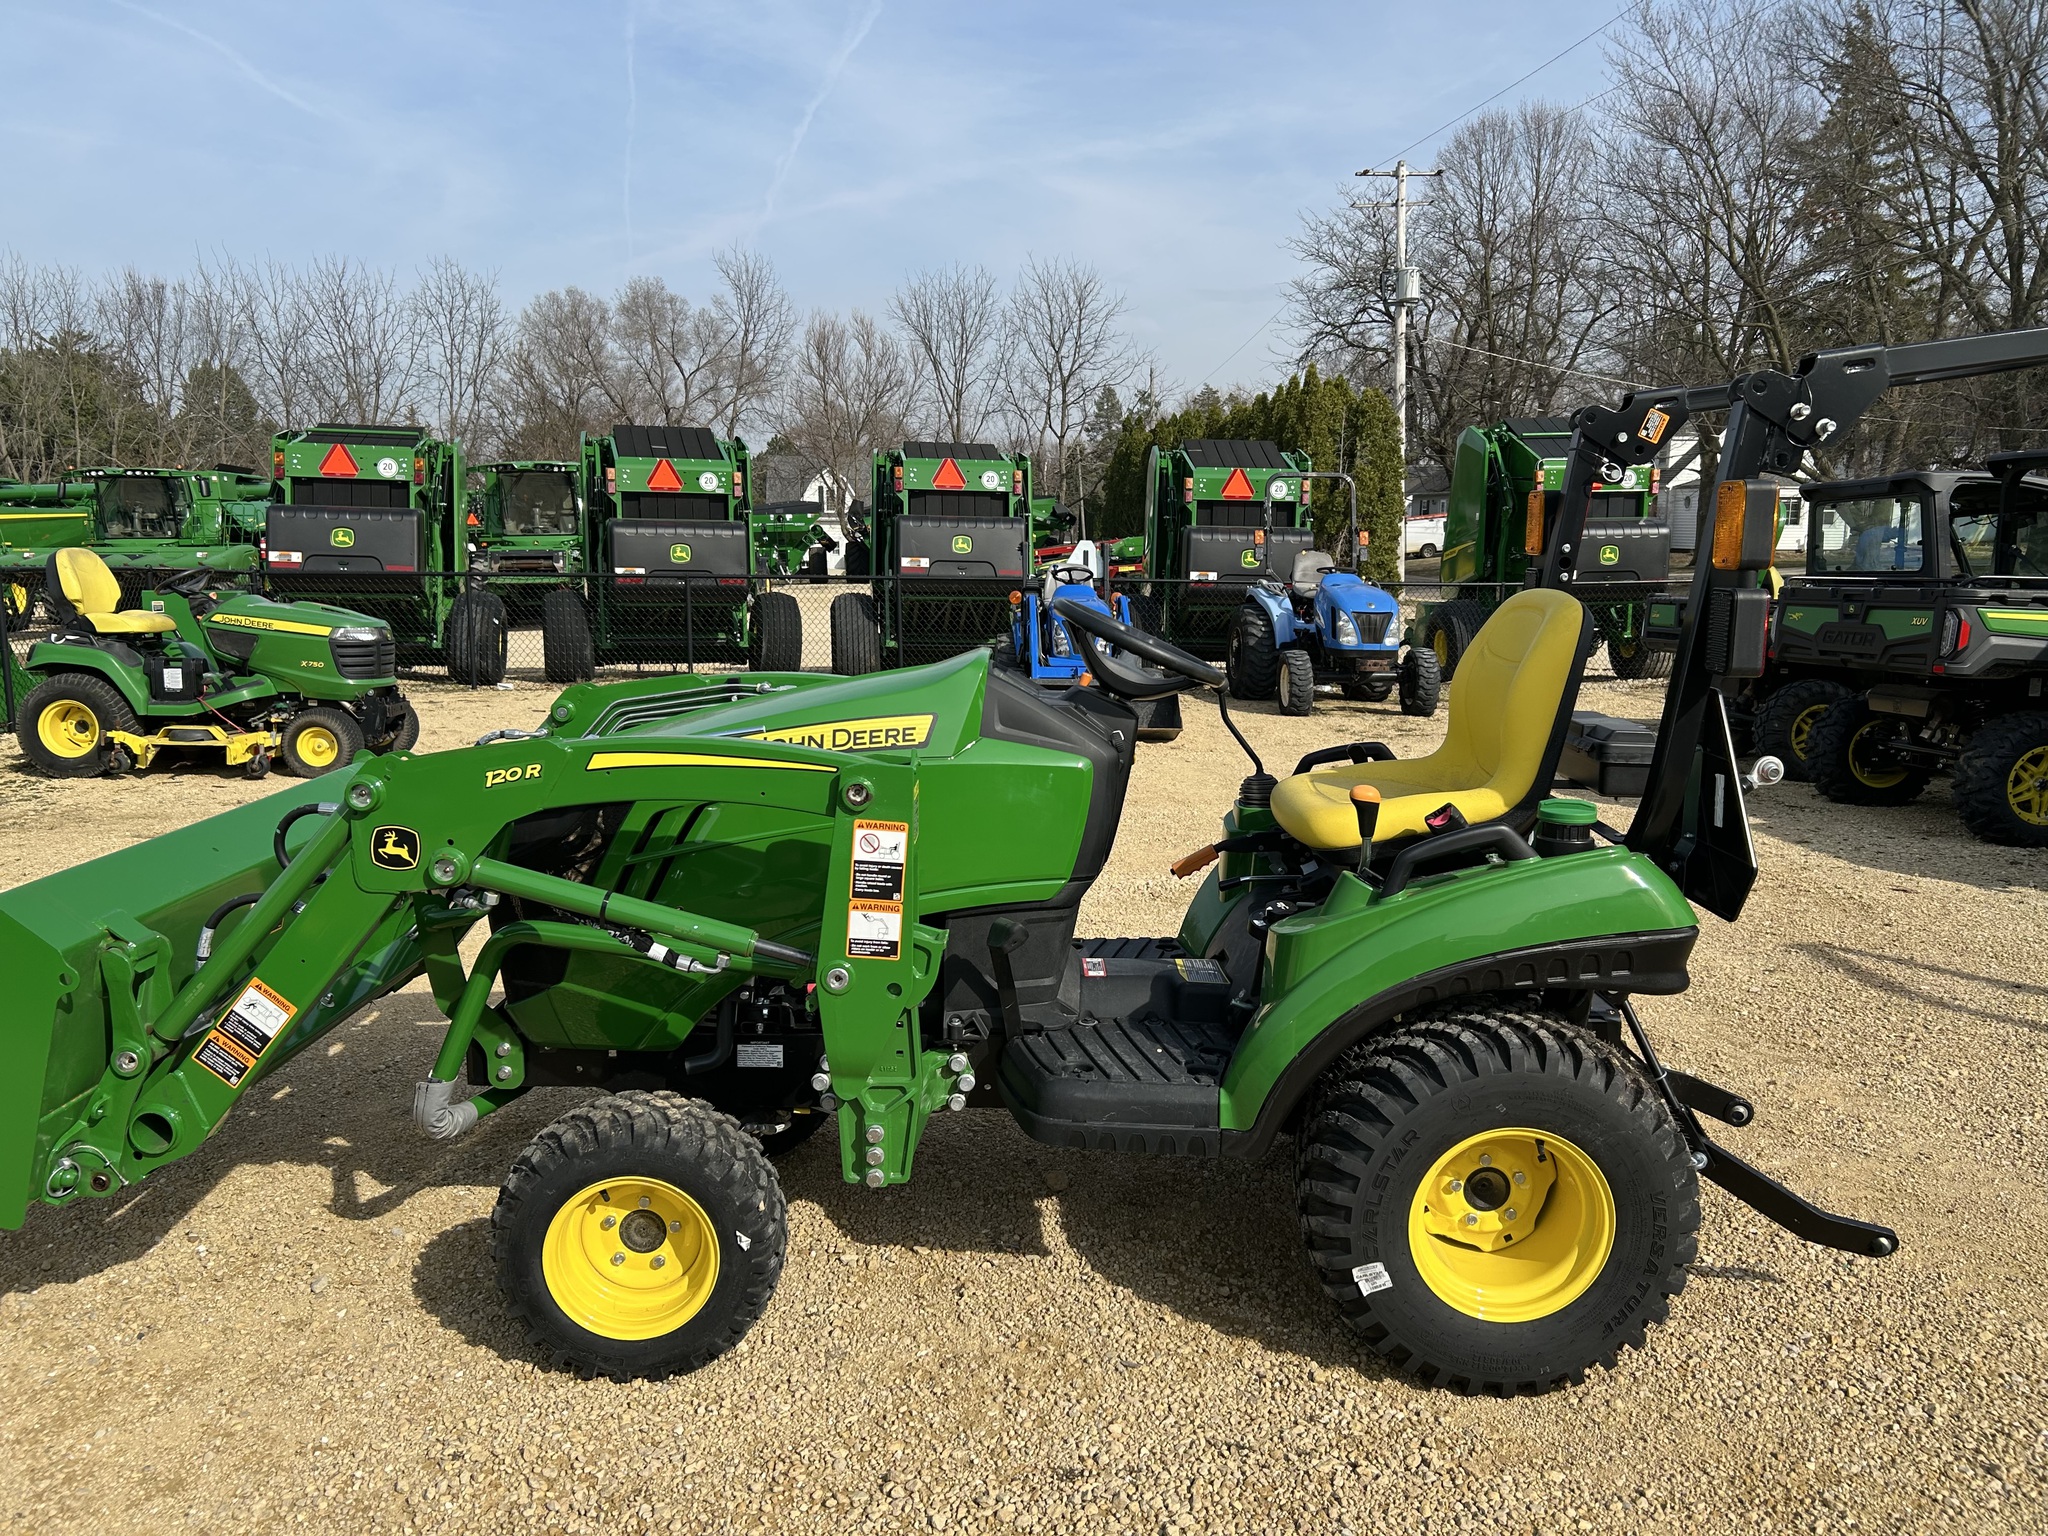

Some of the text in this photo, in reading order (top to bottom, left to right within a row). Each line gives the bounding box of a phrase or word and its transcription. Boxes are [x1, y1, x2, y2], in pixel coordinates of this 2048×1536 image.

[383, 462, 393, 471] 20
[704, 476, 714, 485] 20
[986, 475, 995, 483] 20
[1274, 484, 1284, 493] 20
[220, 616, 274, 629] JOHN DEERE
[1911, 617, 1928, 625] XUV
[1822, 630, 1876, 647] GATOR
[832, 727, 917, 748] DEERE
[485, 763, 542, 788] 120 R
[865, 822, 905, 832] WARNING
[860, 903, 900, 913] WARNING
[263, 988, 291, 1012] WARNING
[222, 1040, 250, 1064] WARNING
[1362, 1129, 1421, 1261] CARLSTAR
[1643, 1190, 1668, 1277] VERSA
[1602, 1281, 1651, 1335] TURF
